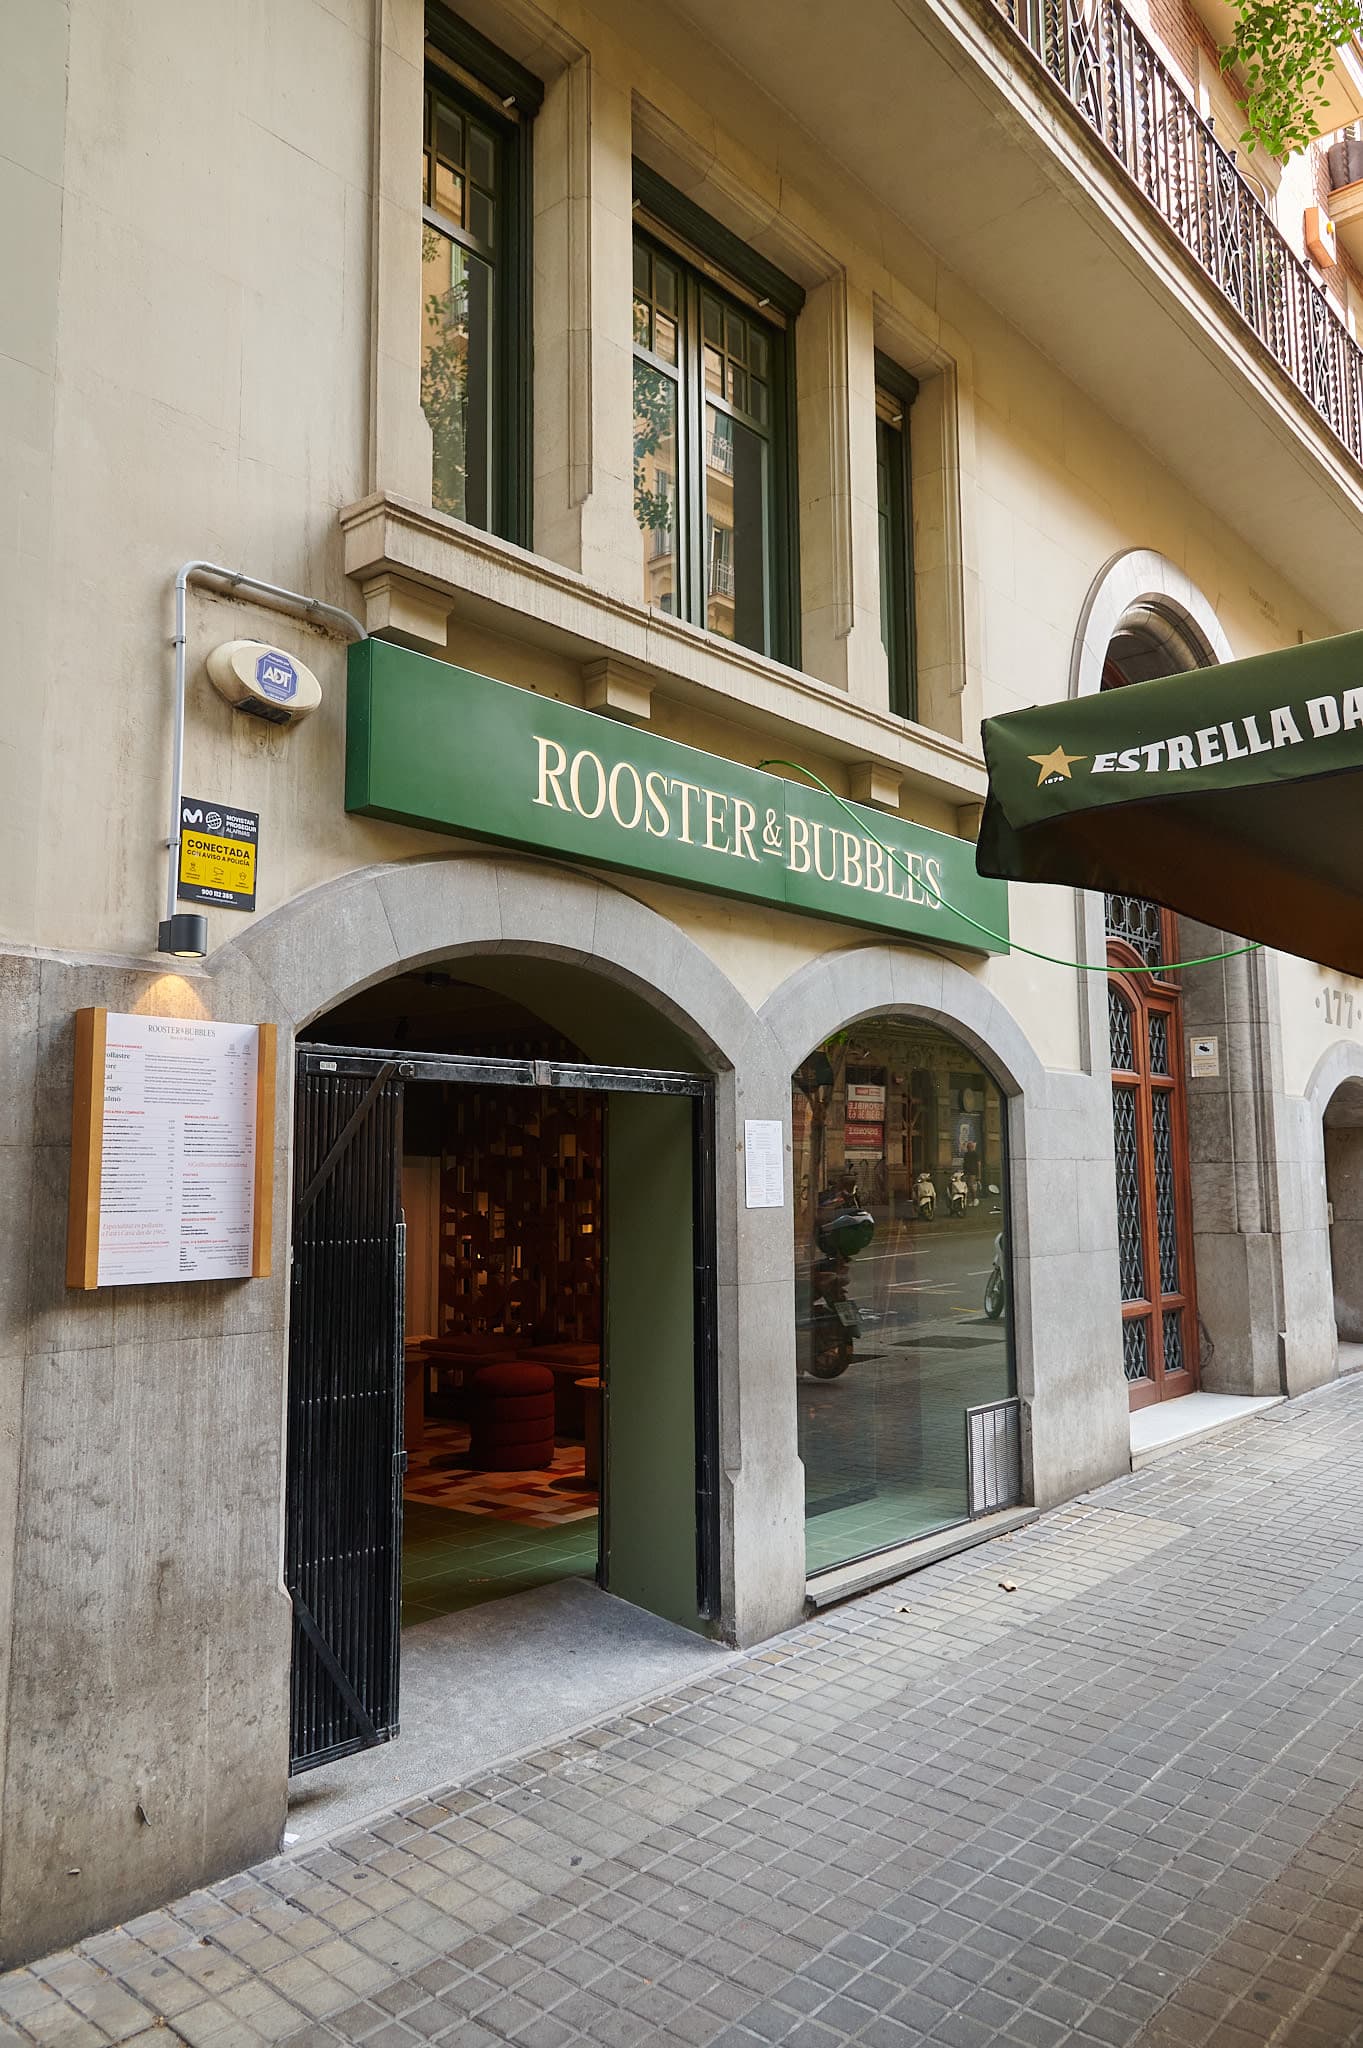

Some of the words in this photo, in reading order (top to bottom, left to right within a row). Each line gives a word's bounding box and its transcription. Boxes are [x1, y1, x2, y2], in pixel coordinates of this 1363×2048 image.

[264, 666, 292, 688] ADT
[1090, 705, 1304, 774] ESTRELLA
[1044, 776, 1064, 784] 1876
[226, 814, 255, 826] MOVISTAR
[532, 735, 760, 863] ROOSTER
[762, 808, 783, 857] &
[786, 815, 943, 910] BUBBLES
[226, 821, 257, 833] PROSEGUR
[187, 839, 250, 860] CONECTADA
[186, 849, 200, 857] CON
[202, 851, 221, 861] AVISO
[226, 857, 250, 867] POLICÍA
[201, 888, 214, 896] 900
[148, 1024, 181, 1034] ROOSTER
[184, 1027, 216, 1038] BUBBLES
[106, 1051, 130, 1060] ollastre
[106, 1085, 122, 1093] eggie
